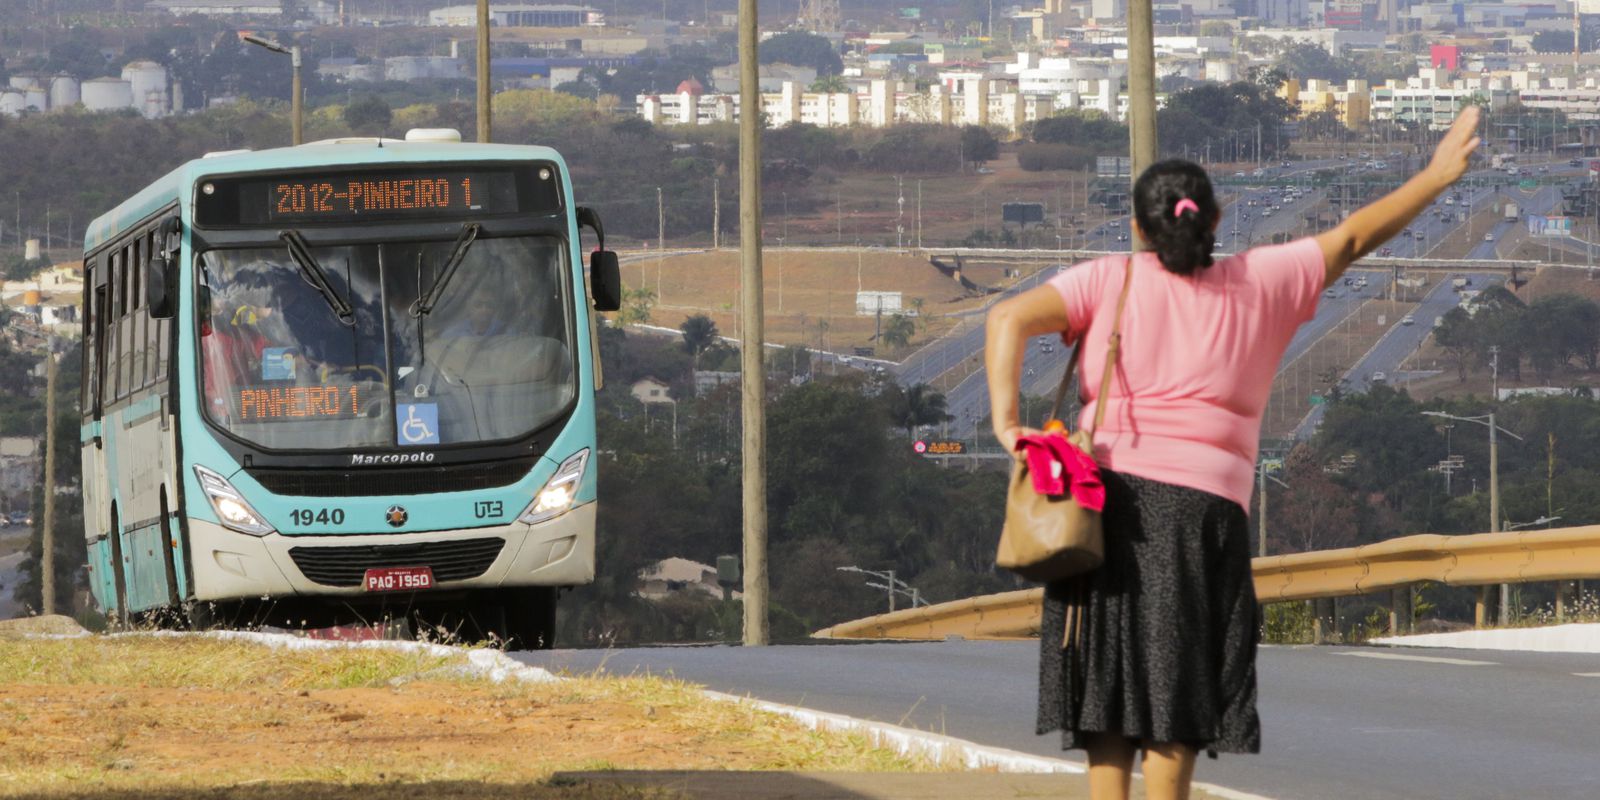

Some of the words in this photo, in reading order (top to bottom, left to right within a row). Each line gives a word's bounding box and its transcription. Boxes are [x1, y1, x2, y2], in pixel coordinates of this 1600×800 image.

[277, 178, 449, 213] 2012-PINHEIRO
[461, 177, 471, 208] 1
[241, 386, 339, 418] PINHEIRO
[349, 385, 358, 415] 1
[352, 451, 434, 464] Marcopolo
[289, 508, 345, 527] 1940
